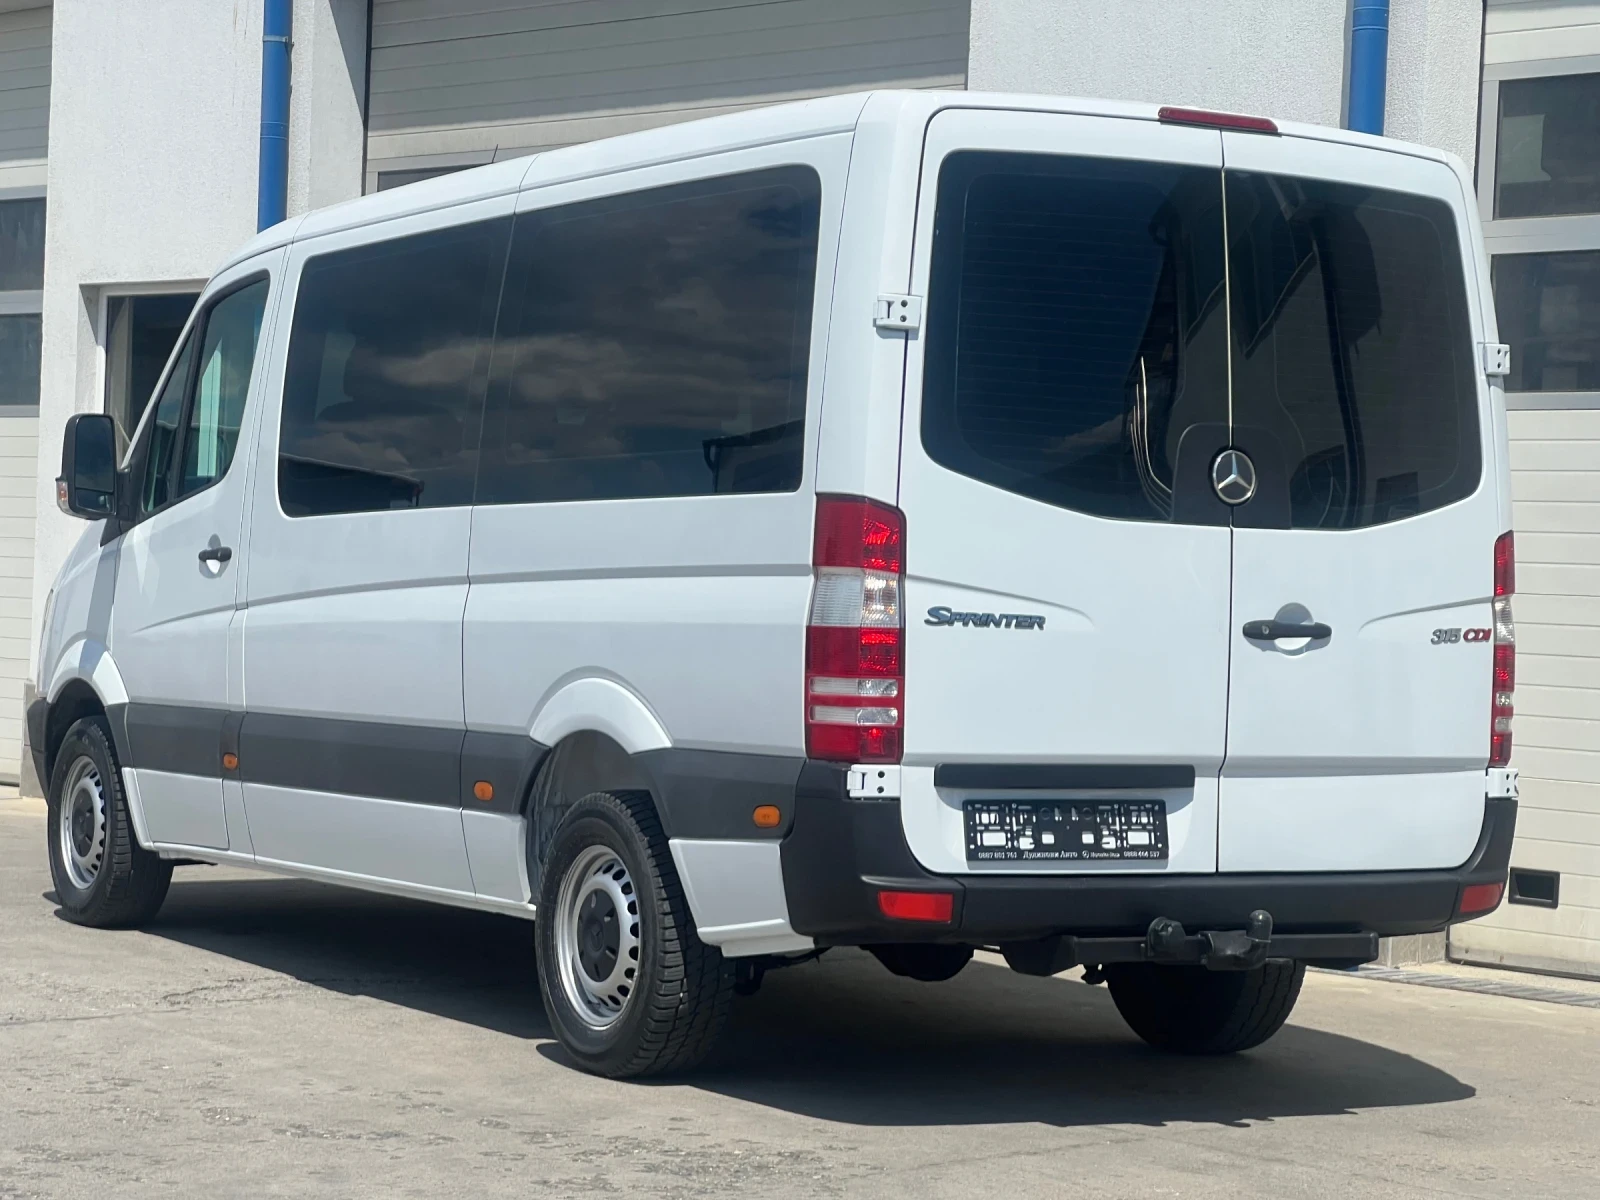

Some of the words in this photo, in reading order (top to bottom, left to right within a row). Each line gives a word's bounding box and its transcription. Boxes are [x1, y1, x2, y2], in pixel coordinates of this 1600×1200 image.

[924, 605, 1046, 630] SPRINTER
[1430, 628, 1462, 645] 315
[1463, 628, 1492, 643] CDI
